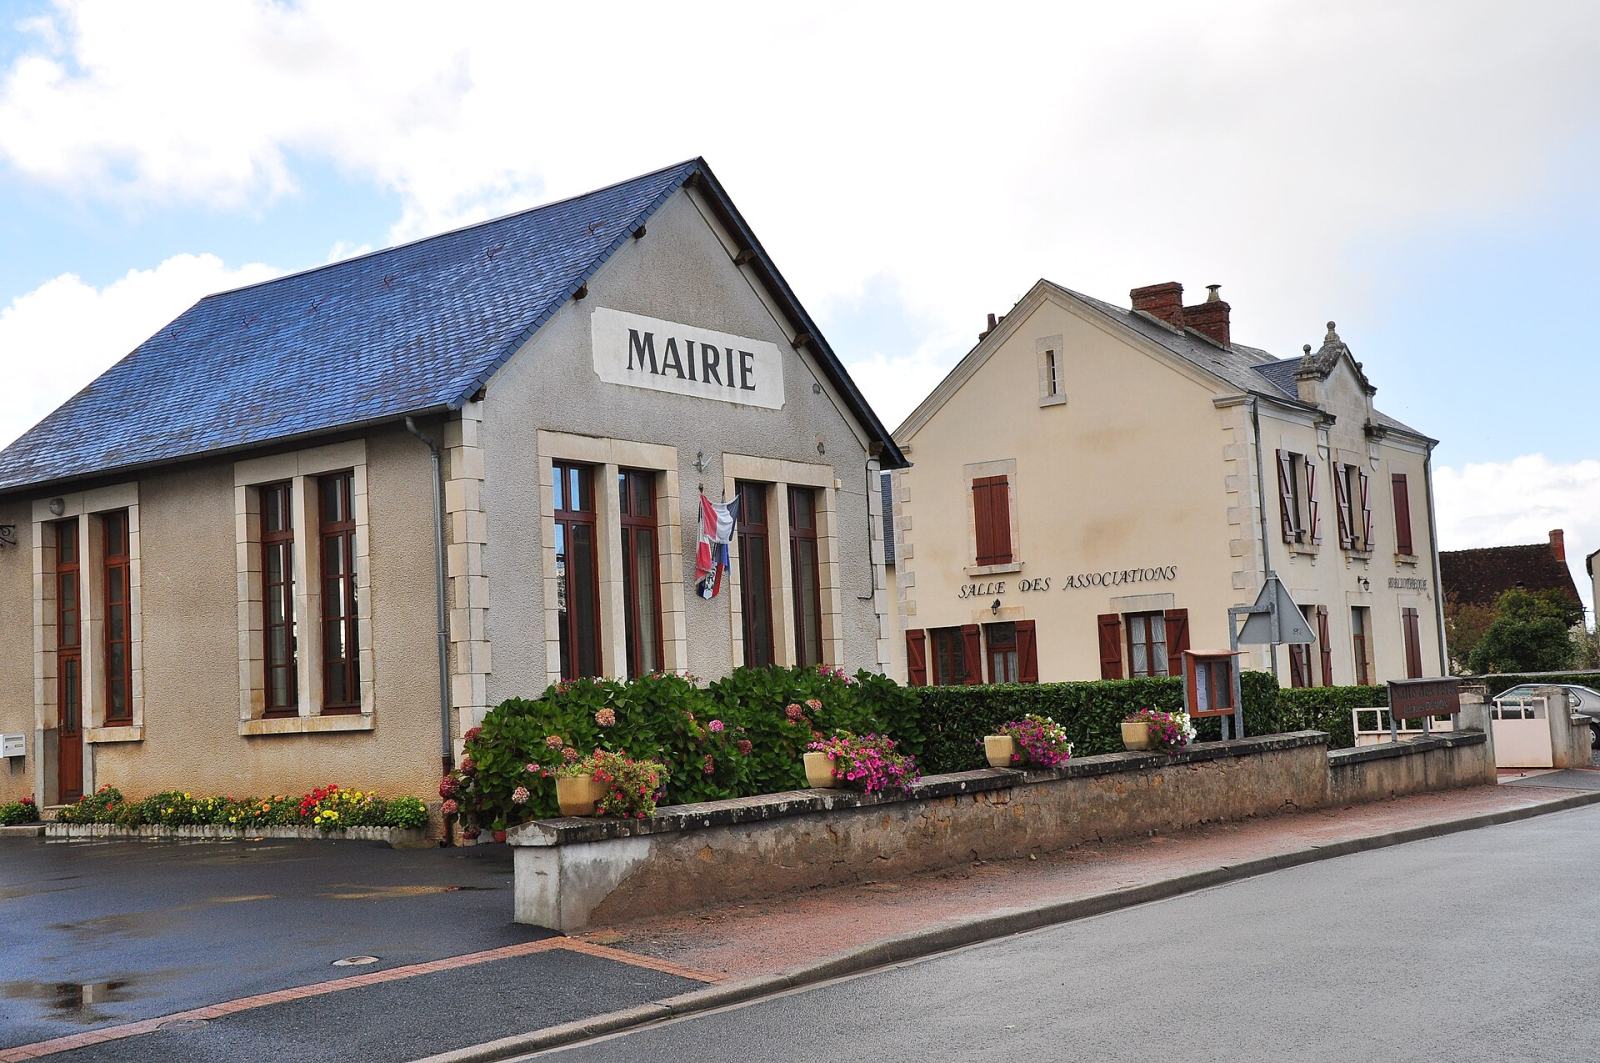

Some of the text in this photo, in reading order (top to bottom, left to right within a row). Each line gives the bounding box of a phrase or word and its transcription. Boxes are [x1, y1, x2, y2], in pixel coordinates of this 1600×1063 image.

[626, 328, 756, 391] MAIRIE
[958, 565, 1178, 599] SALLE DES ASSOCIATIONS
